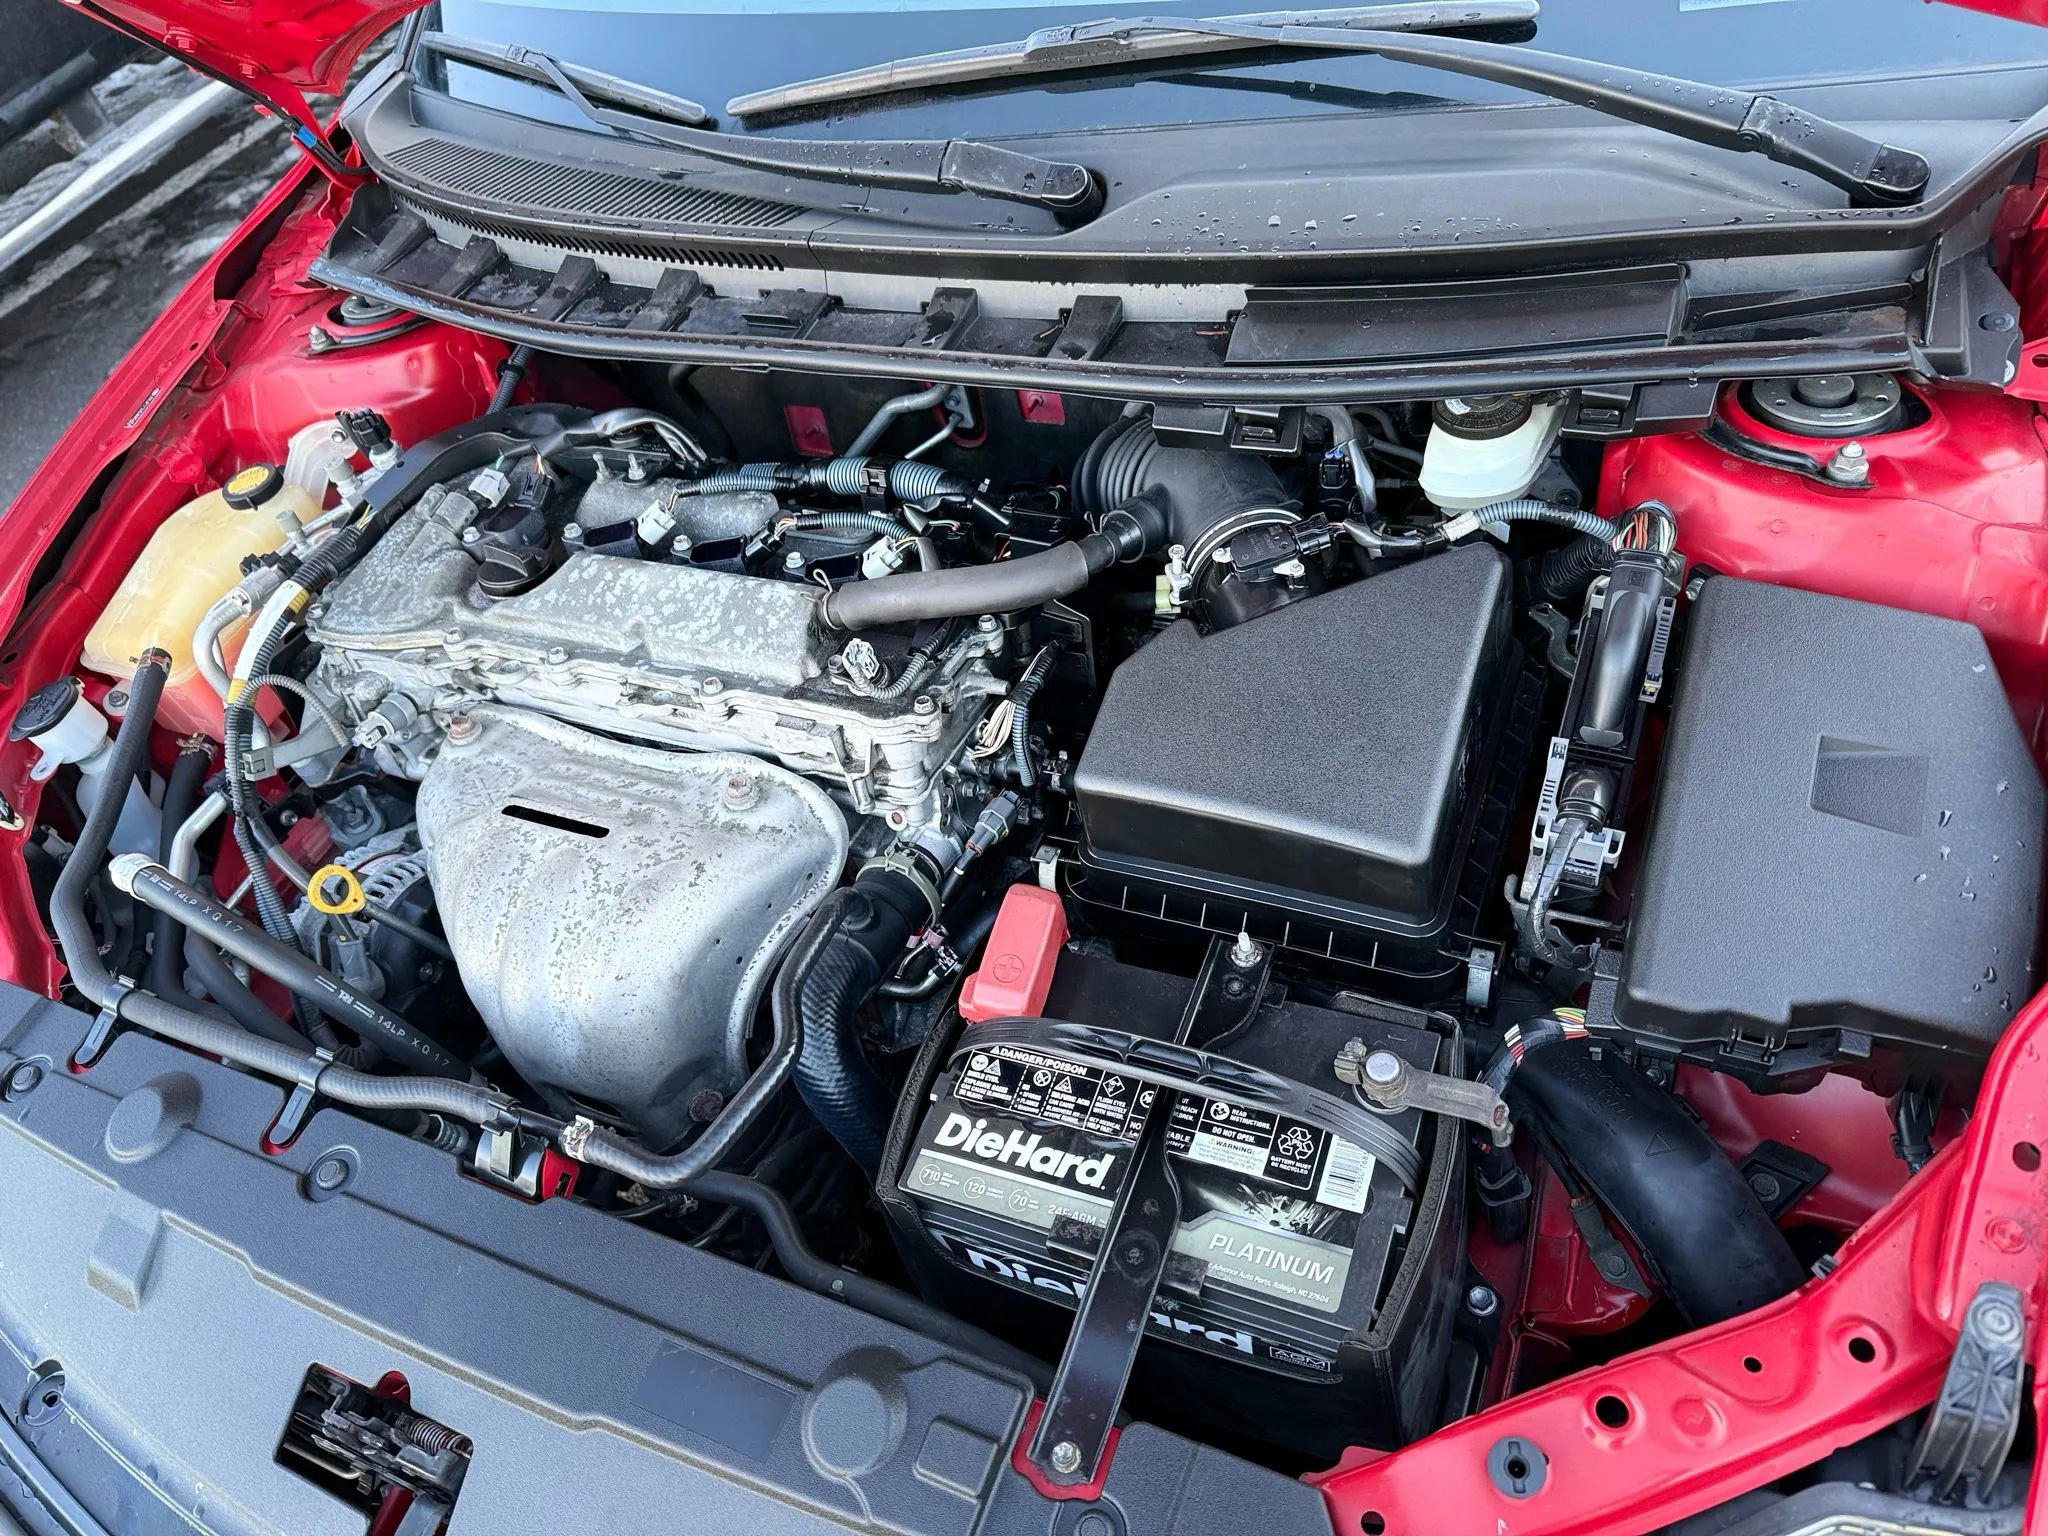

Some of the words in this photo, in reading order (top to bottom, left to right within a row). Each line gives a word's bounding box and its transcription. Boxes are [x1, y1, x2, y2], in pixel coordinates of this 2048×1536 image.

[174, 890, 198, 905] 14LP
[378, 1016, 406, 1037] 14LP
[1001, 1048, 1088, 1076] DANGER/POISON
[964, 1077, 992, 1090] EXPLOSIVE
[1048, 1098, 1059, 1106] CAN
[1076, 1098, 1090, 1106] ACID
[1096, 1096, 1113, 1104] FLUSH
[1113, 1099, 1126, 1108] EYES
[1092, 1107, 1106, 1115] WITH
[1232, 1109, 1247, 1117] READ
[1086, 1122, 1100, 1130] HELP
[1099, 1119, 1120, 1130] MEDICAL
[1230, 1115, 1272, 1130] INSTRUCTIONS.
[1212, 1126, 1222, 1134] DO
[1222, 1129, 1236, 1138] NOT
[1237, 1132, 1256, 1143] OPEN.
[1270, 1156, 1296, 1166] BATTERY
[1296, 1161, 1312, 1170] MUST
[1279, 1164, 1308, 1175] RECYCLED
[923, 1168, 940, 1181] 710
[968, 1182, 986, 1194] 120
[1013, 1194, 1027, 1206] 70
[1208, 1234, 1335, 1284] PLATINUM
[1212, 1263, 1238, 1276] Advance
[1240, 1268, 1254, 1280] Auto
[1254, 1276, 1272, 1287] Parts,
[1272, 1280, 1297, 1295] Raleigh,
[1275, 1350, 1325, 1366] AGM
